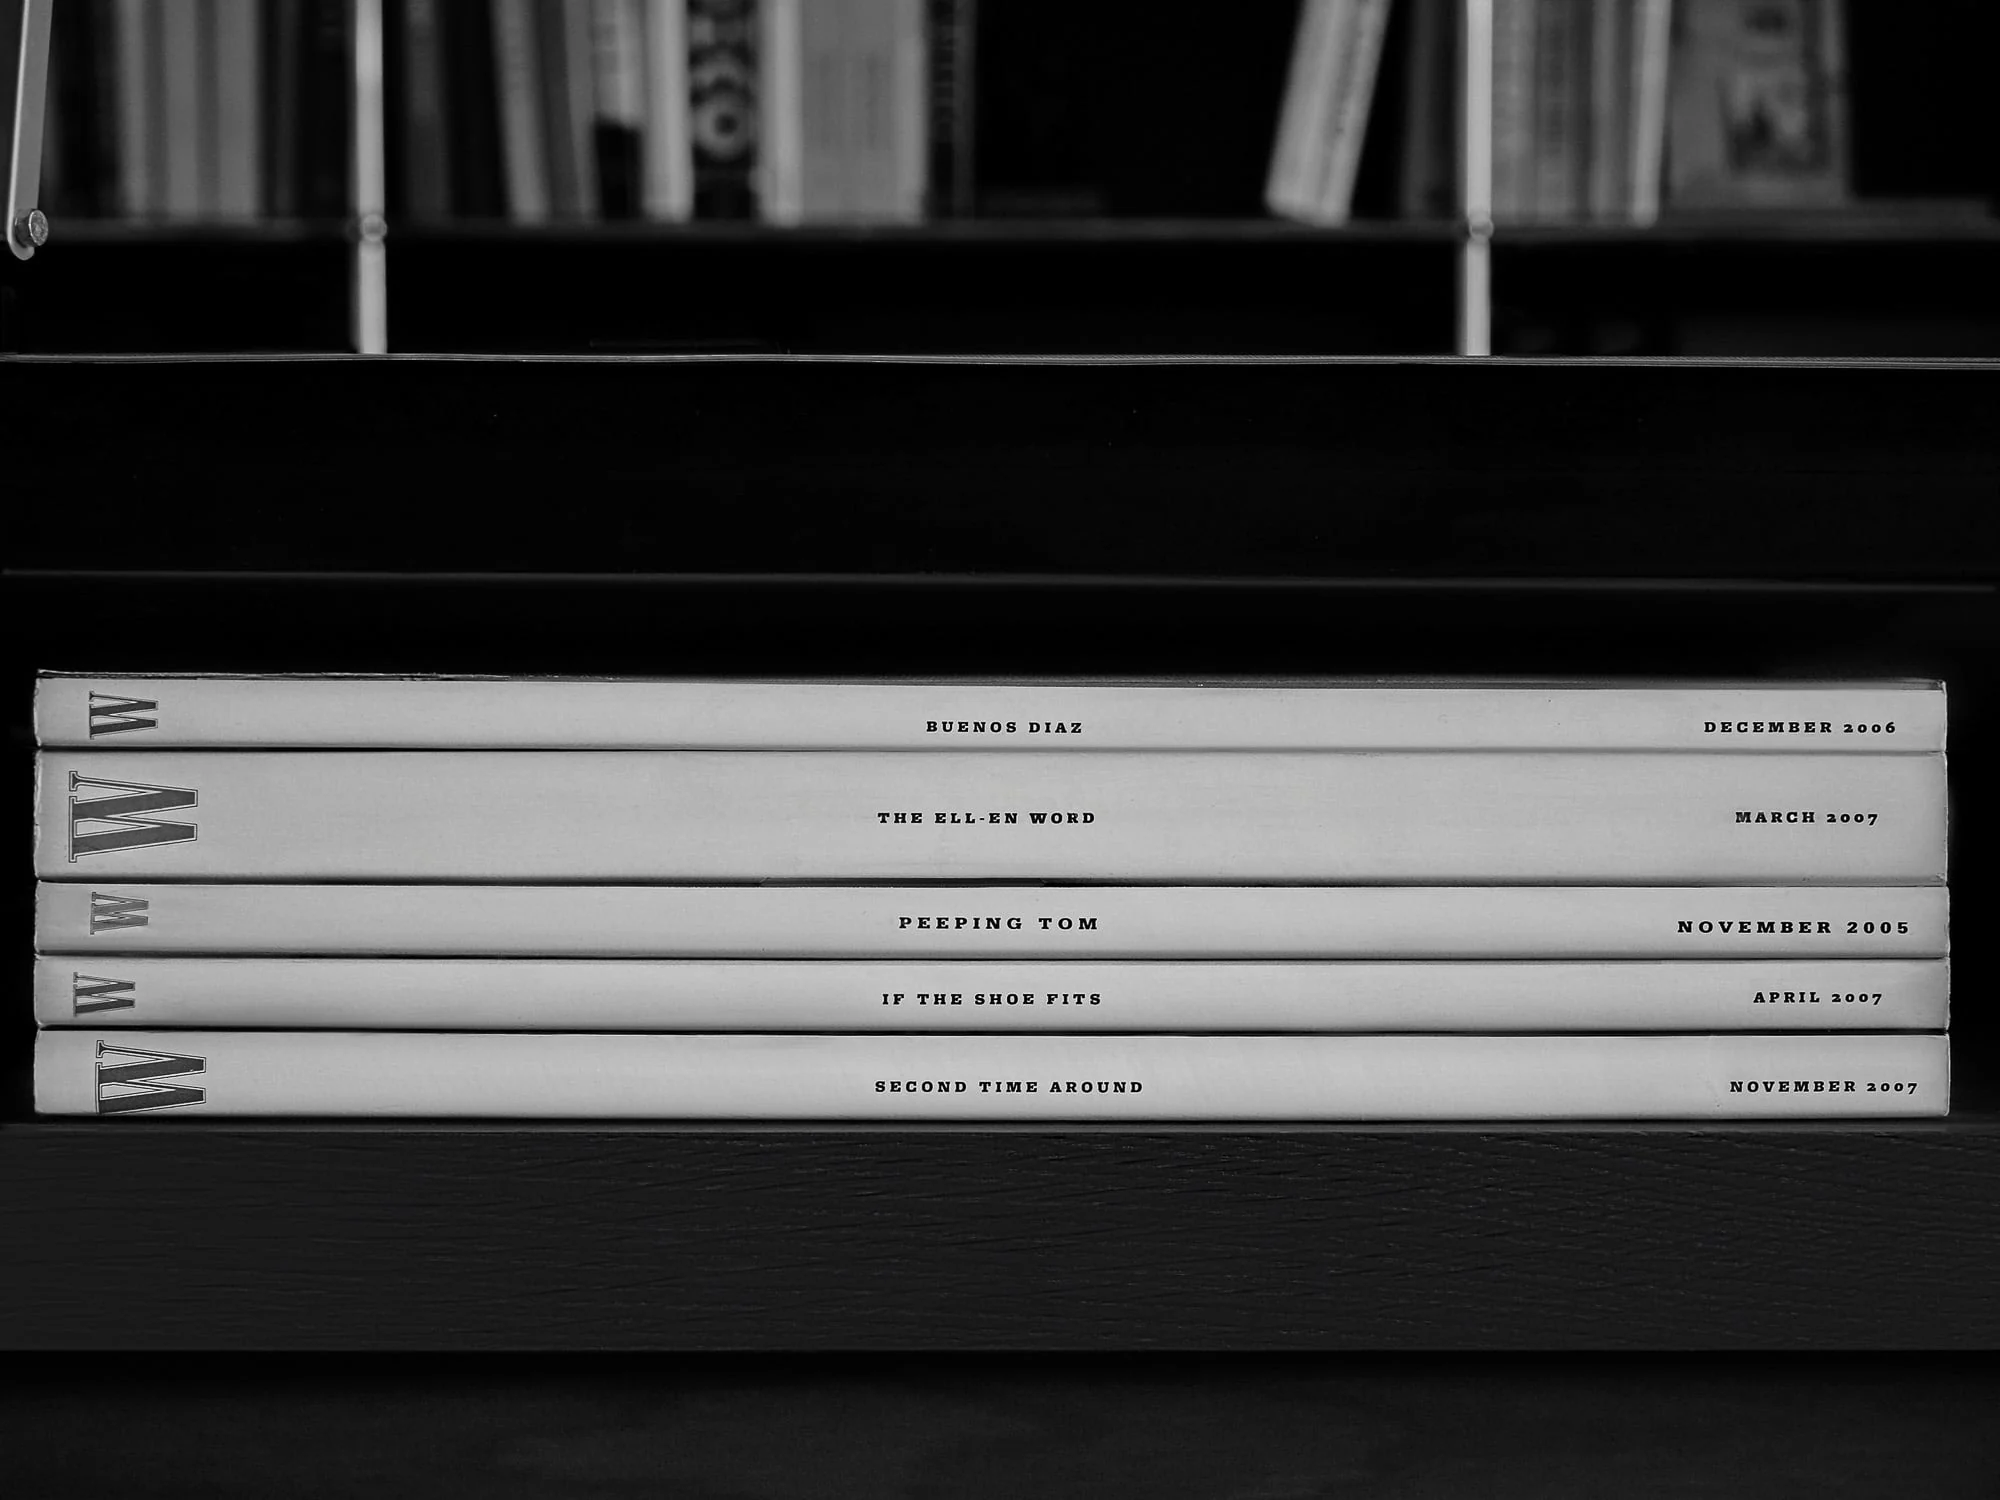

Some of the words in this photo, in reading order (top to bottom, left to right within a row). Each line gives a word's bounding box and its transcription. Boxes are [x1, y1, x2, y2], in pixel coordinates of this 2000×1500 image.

[88, 691, 158, 739] W
[926, 720, 1017, 734] BUENOS
[1028, 721, 1082, 734] DIAZ
[1703, 721, 1832, 734] DECEMBER
[1843, 721, 1896, 734] 2006
[68, 771, 198, 863] W
[877, 812, 923, 824] THE
[934, 812, 1018, 825] ELL-EN
[1028, 812, 1095, 825] WORD
[1735, 811, 1816, 824] MARCH
[1826, 813, 1878, 826] 2007
[90, 892, 149, 935] W
[898, 916, 1022, 930] PEEPING
[1038, 917, 1098, 930] TOM
[1677, 920, 1832, 934] NOVEMBER
[1846, 921, 1909, 935] 2005
[73, 972, 135, 1016] W
[882, 993, 905, 1006] IF
[916, 993, 963, 1006] THE
[974, 993, 1035, 1006] SHOE
[1046, 993, 1101, 1006] FITS
[1752, 991, 1821, 1004] APRIL
[1831, 993, 1883, 1006] 2007
[95, 1039, 207, 1114] W
[874, 1080, 967, 1093] SECOND
[978, 1081, 1038, 1093] TIME
[1049, 1081, 1143, 1094] AROUND
[1729, 1080, 1856, 1093] NOVEMBER
[1866, 1082, 1918, 1095] 2007
